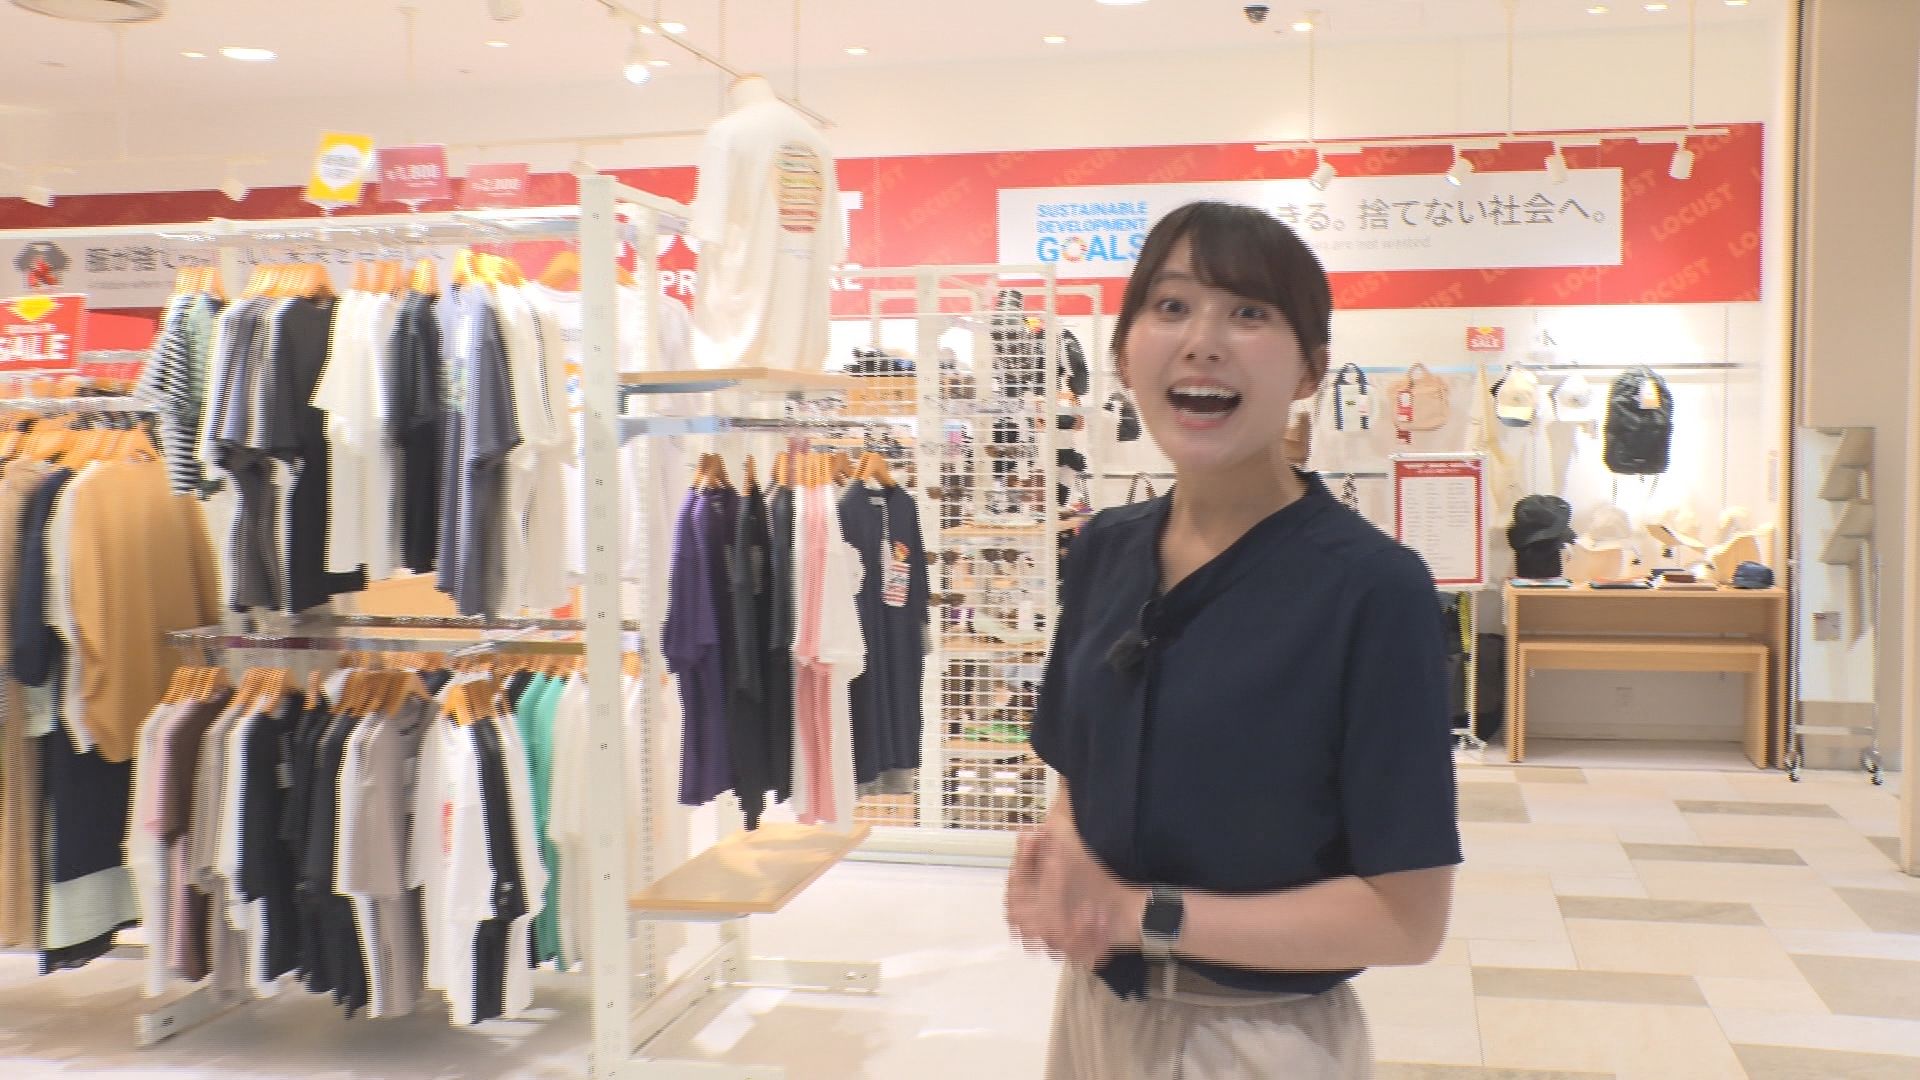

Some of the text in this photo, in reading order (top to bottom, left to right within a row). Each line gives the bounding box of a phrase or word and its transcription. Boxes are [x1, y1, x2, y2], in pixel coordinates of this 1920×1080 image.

[1036, 201, 1148, 218] SUSTAINABLE
[1649, 181, 1735, 242] LOCUST
[1036, 218, 1147, 234] DEVELOPMENT
[1036, 233, 1145, 264] GOALS
[1469, 337, 1502, 350] SALE
